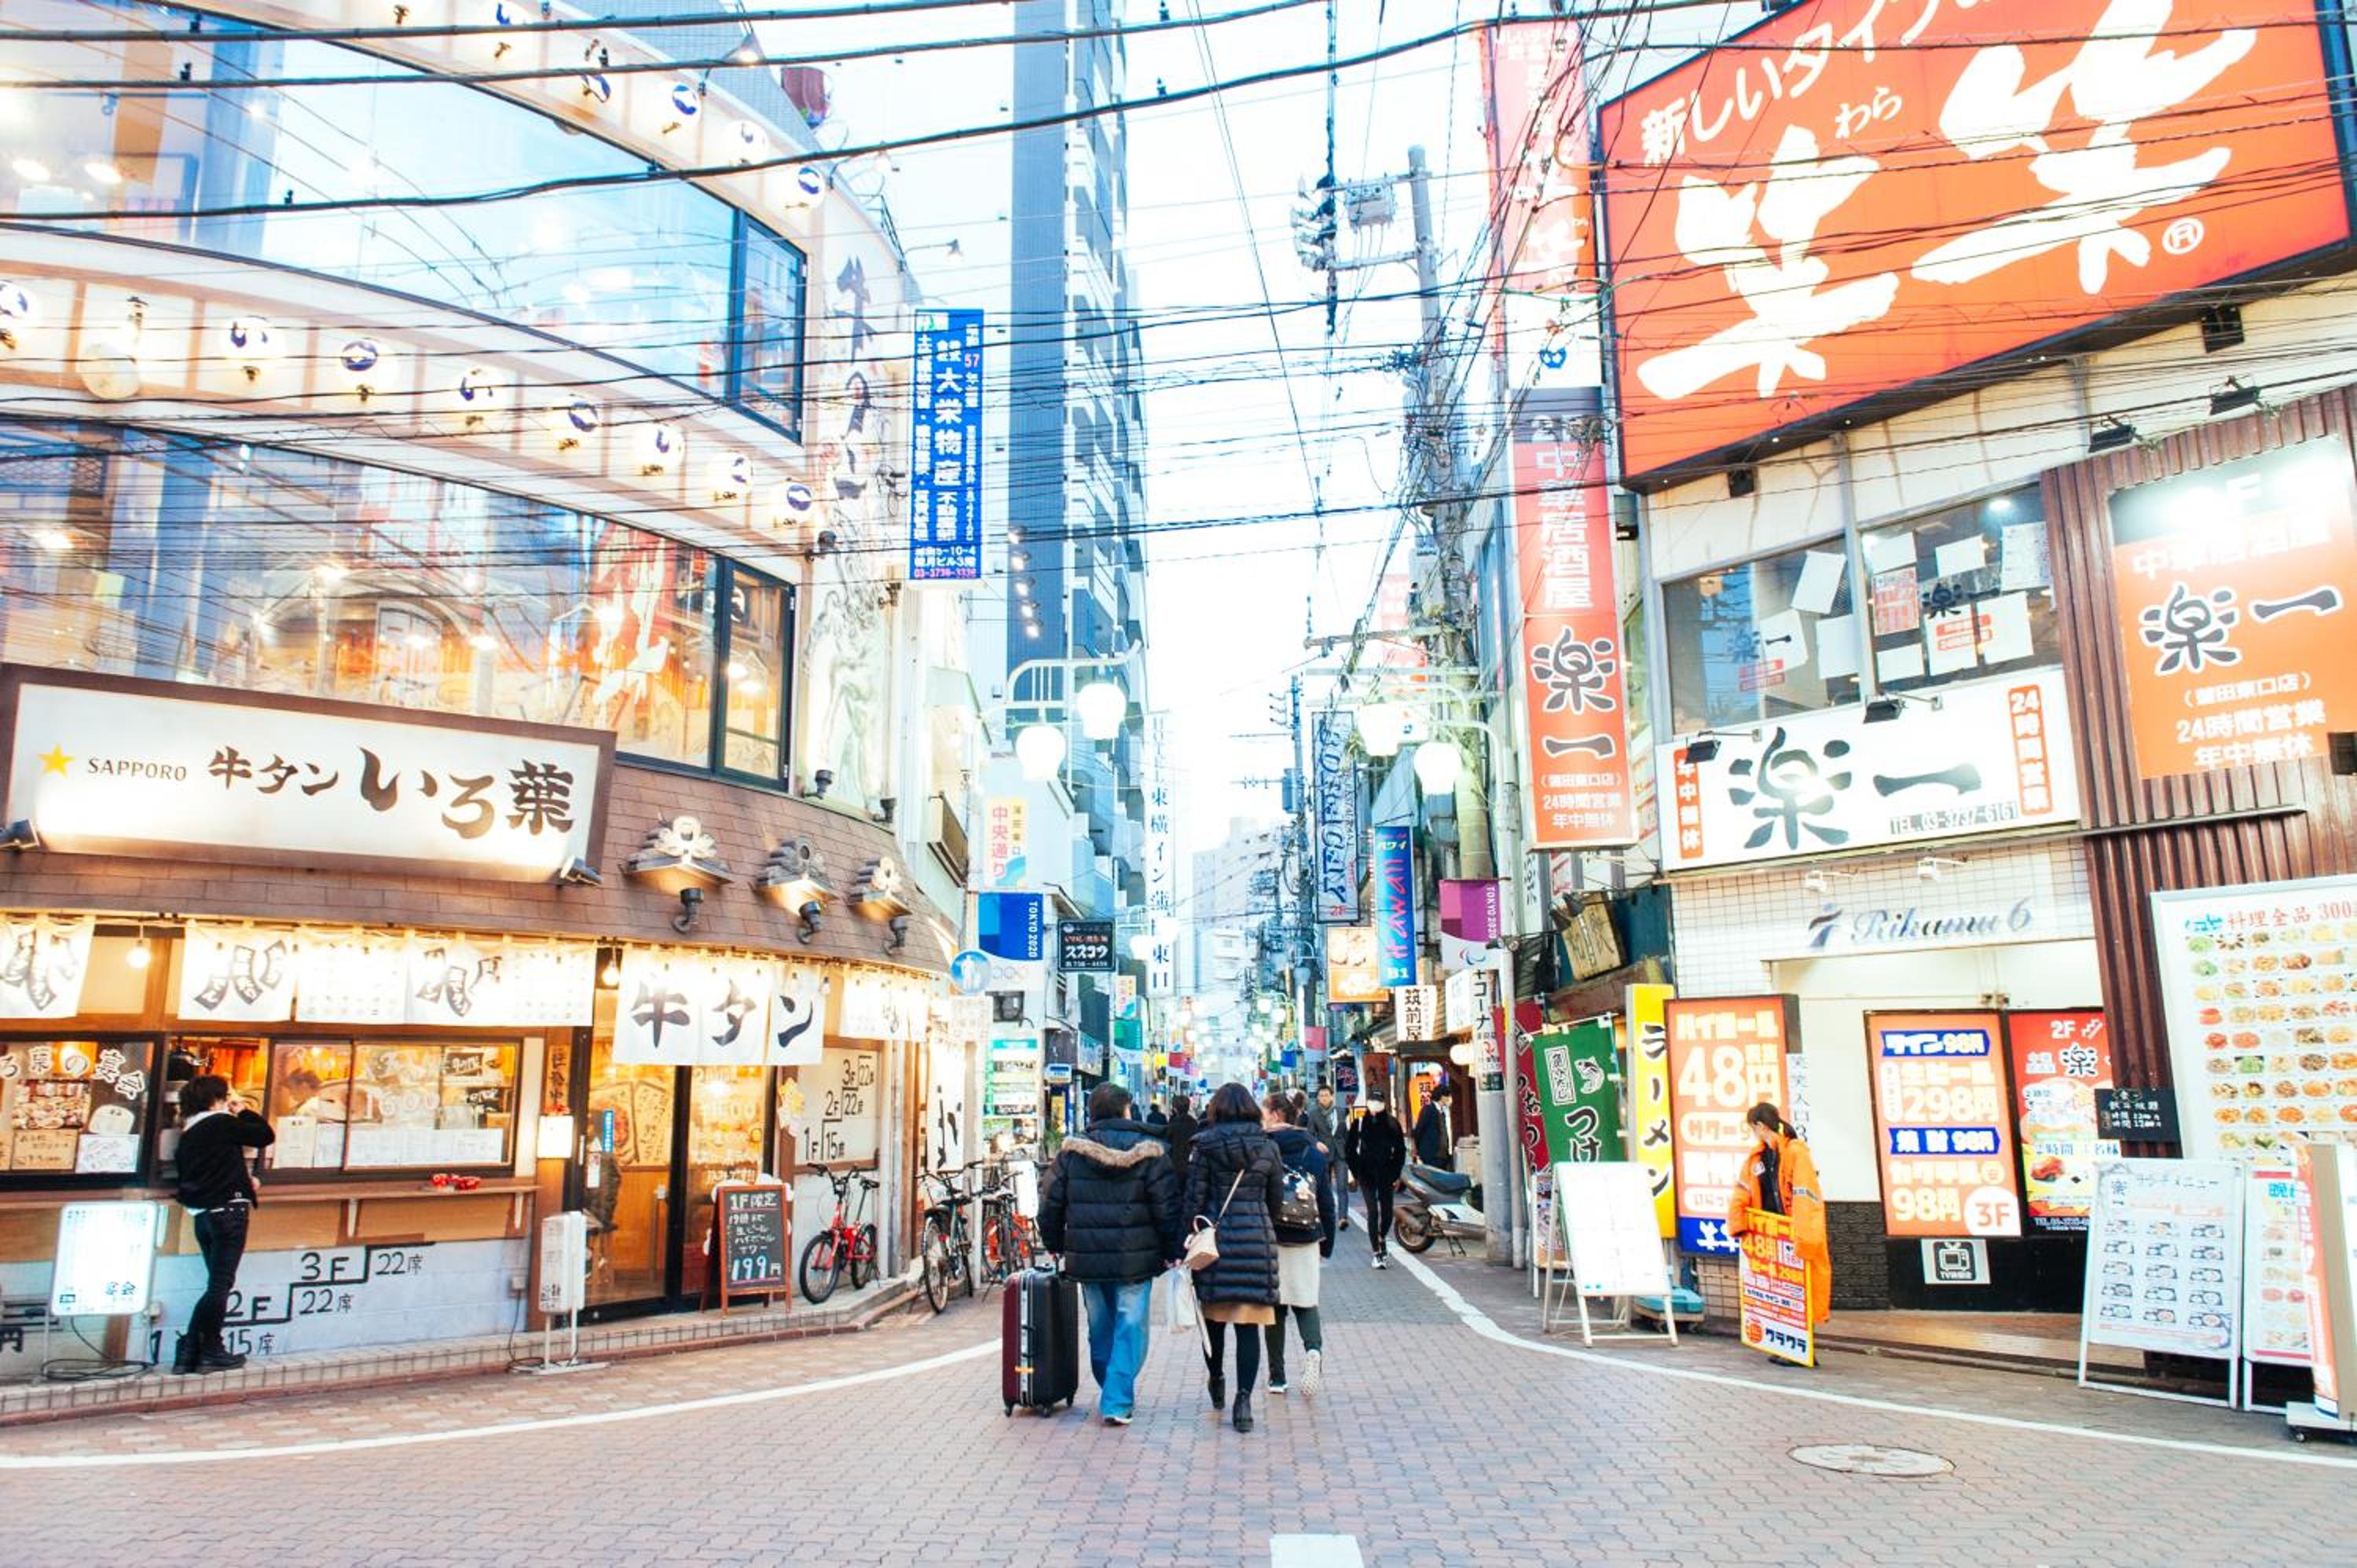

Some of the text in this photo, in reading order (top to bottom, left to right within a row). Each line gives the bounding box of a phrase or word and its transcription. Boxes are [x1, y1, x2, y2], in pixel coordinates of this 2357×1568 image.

[1835, 86, 1903, 139] わら
[1637, 0, 2258, 399] 笑笑
[933, 367, 963, 485] 大栄物産
[1536, 448, 1593, 610] 中華居酒屋
[2142, 584, 2340, 673] 楽一
[1531, 626, 1615, 760] 楽一
[2176, 699, 2326, 744] 24時間営業
[87, 756, 188, 782] SAPPORO
[208, 745, 574, 840] 牛タン いろ葉
[1728, 727, 1982, 850] 楽一
[992, 804, 1008, 877] 中央通り
[1152, 787, 1170, 988] 東横イン蒲東口
[1028, 901, 1038, 958] TOKYO 2020
[630, 977, 814, 1049] 牛タン
[2050, 1020, 2077, 1039] 2F
[842, 1059, 856, 1085] 3F
[1677, 1045, 1782, 1108] 48円
[825, 1090, 839, 1116] 2F
[1640, 1024, 1670, 1196] ラーメン
[1902, 1086, 1999, 1122] 298円
[805, 1127, 819, 1160] 1F
[1891, 1187, 1961, 1222] 98円
[1975, 1202, 2011, 1227] 3F
[301, 1251, 423, 1282] 3F 22席
[731, 1255, 781, 1281] 199円
[225, 1289, 354, 1321] 2F 22席
